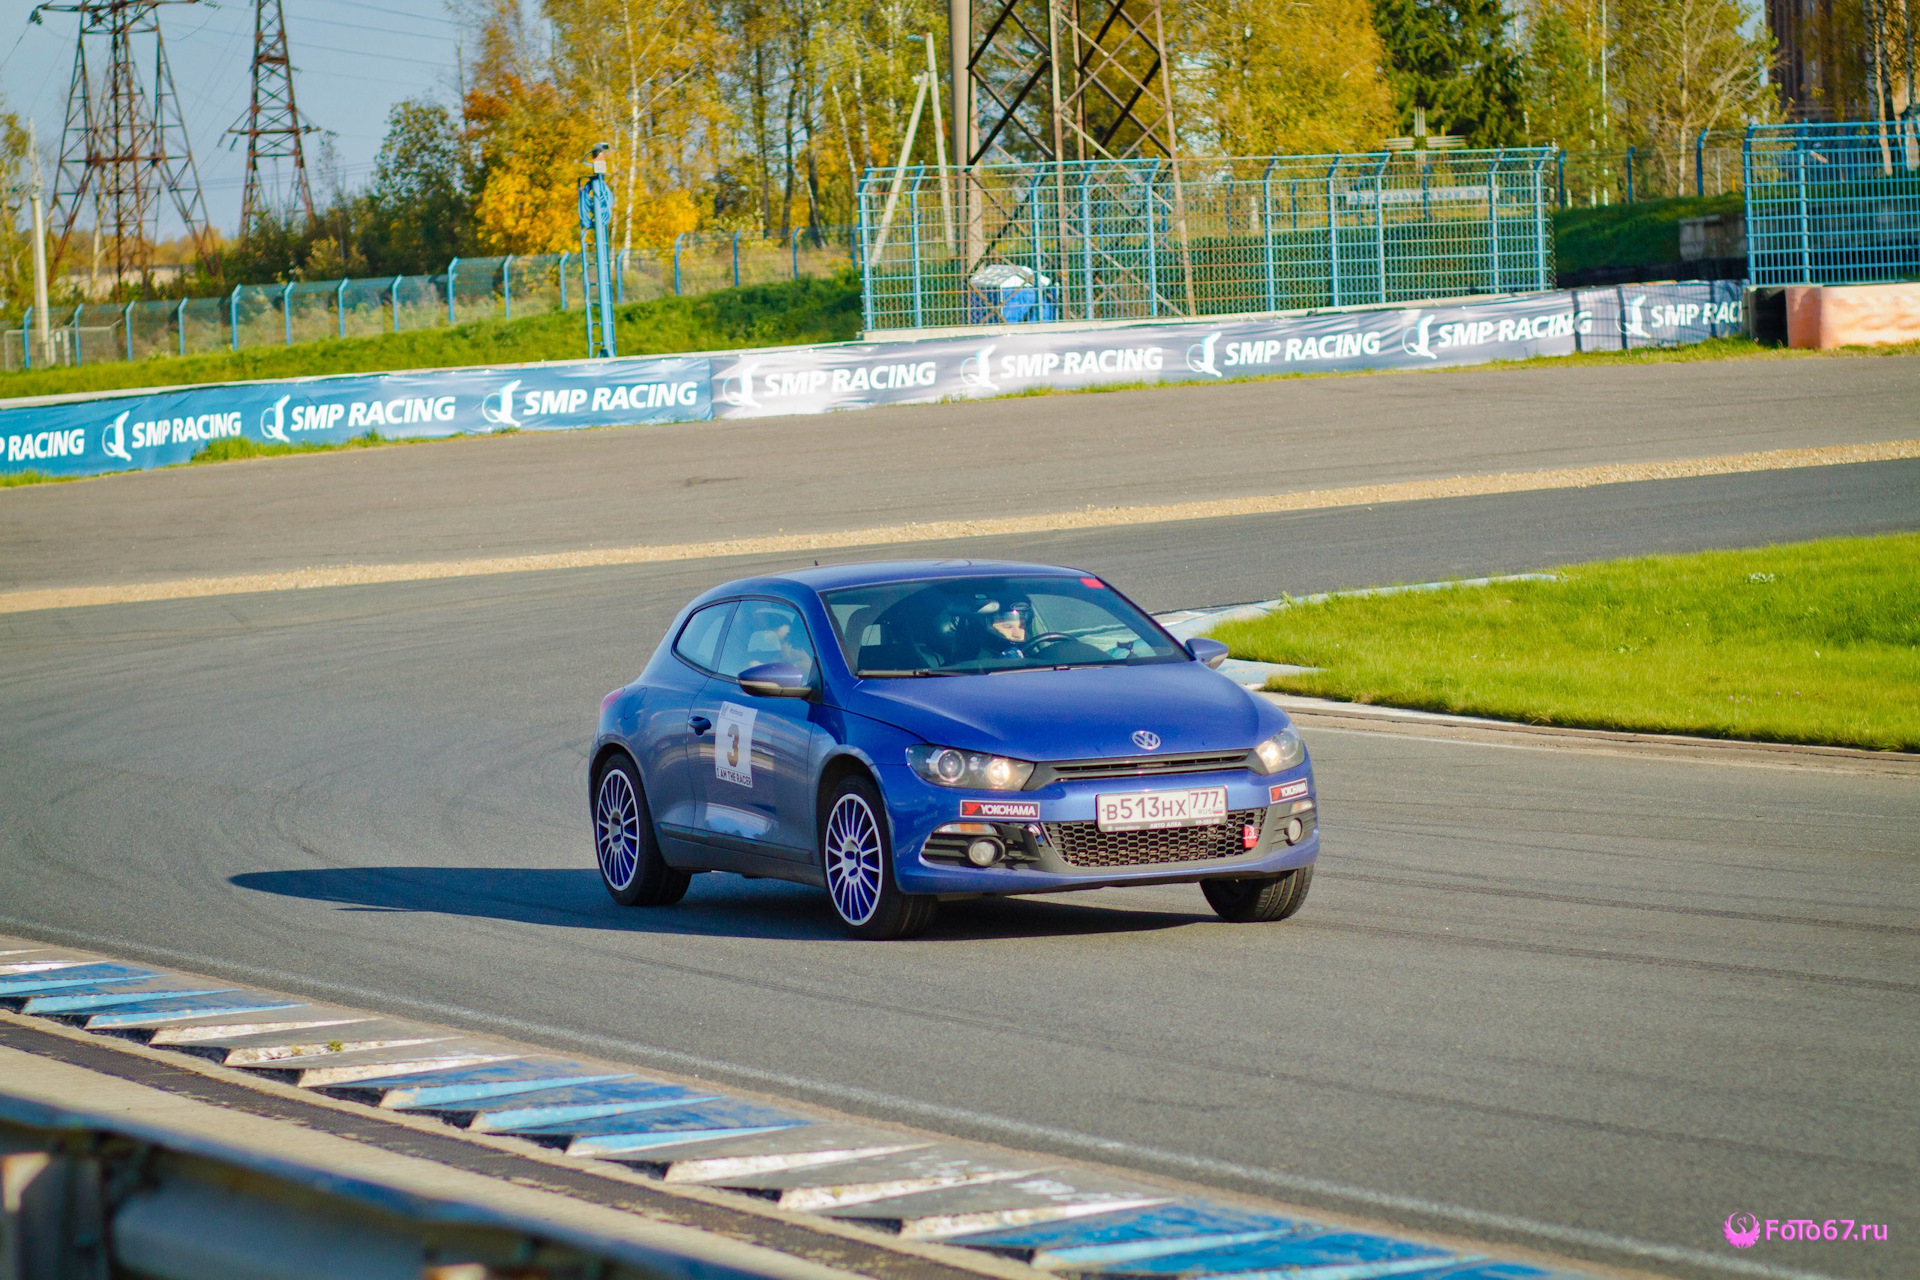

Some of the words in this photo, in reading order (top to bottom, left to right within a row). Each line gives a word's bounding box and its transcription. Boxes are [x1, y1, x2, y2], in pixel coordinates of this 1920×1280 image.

[1437, 320, 1494, 349] SMP
[1499, 311, 1593, 342] RACING
[1651, 303, 1700, 328] SMP
[1000, 352, 1060, 379] SMP
[1063, 346, 1164, 375] RACING
[1224, 340, 1281, 366] SMP
[1284, 331, 1381, 361] RACING
[763, 370, 829, 398] SMP
[832, 361, 937, 393] RACING
[290, 404, 344, 431] SMP
[348, 396, 456, 426] RACING
[522, 388, 588, 416] SMP
[591, 381, 698, 411] RACING
[8, 428, 85, 462] RACING
[131, 419, 171, 449] SMP
[172, 411, 242, 442] RACING
[727, 723, 740, 768] 3
[727, 770, 736, 782] THE
[980, 804, 1036, 816] YOKOHAMA
[1190, 791, 1219, 809] 777
